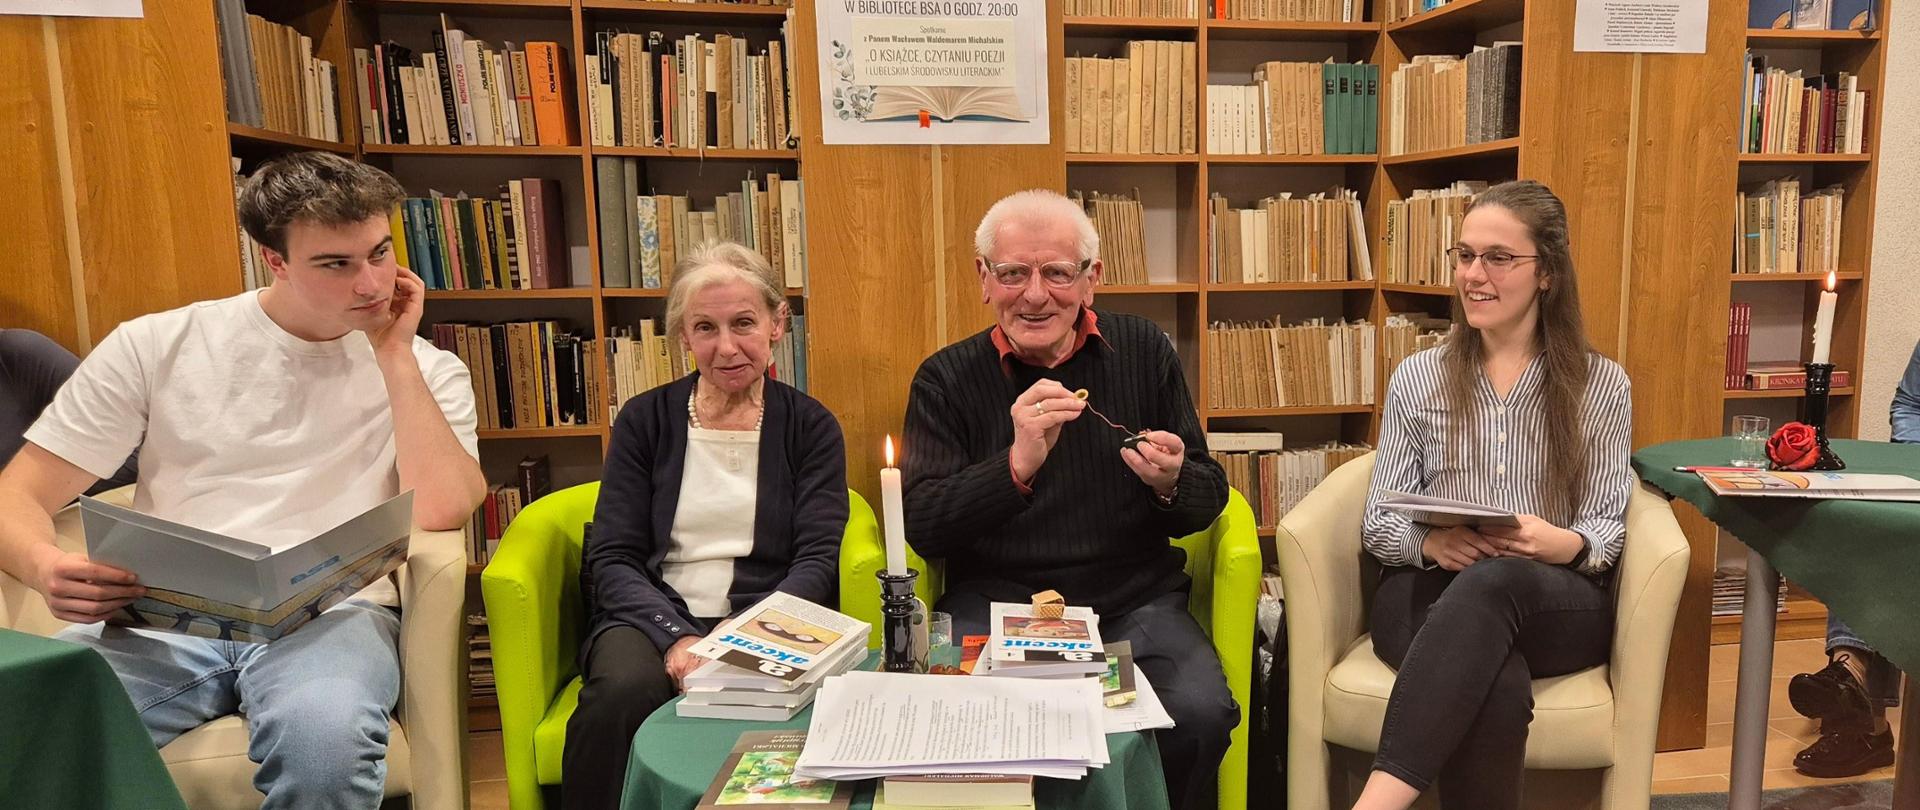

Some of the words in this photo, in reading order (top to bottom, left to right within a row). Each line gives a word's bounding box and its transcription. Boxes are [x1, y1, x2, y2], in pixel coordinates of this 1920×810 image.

[859, 0, 917, 14] BIBLIOTECE
[920, 2, 942, 15] BSA
[944, 2, 951, 16] O
[954, 2, 986, 16] GODZ.
[988, 3, 1018, 16] 20:00
[880, 48, 922, 64] KSIĄŻCE,
[925, 50, 971, 62] CZYTANIU
[974, 50, 1004, 63] POEZJI
[870, 66, 909, 76] LUBELSKIM
[911, 66, 958, 76] ŚRODOWISKU
[456, 64, 468, 104] MONIUSZKO
[718, 634, 810, 665] akcent
[1004, 639, 1095, 651] akcent
